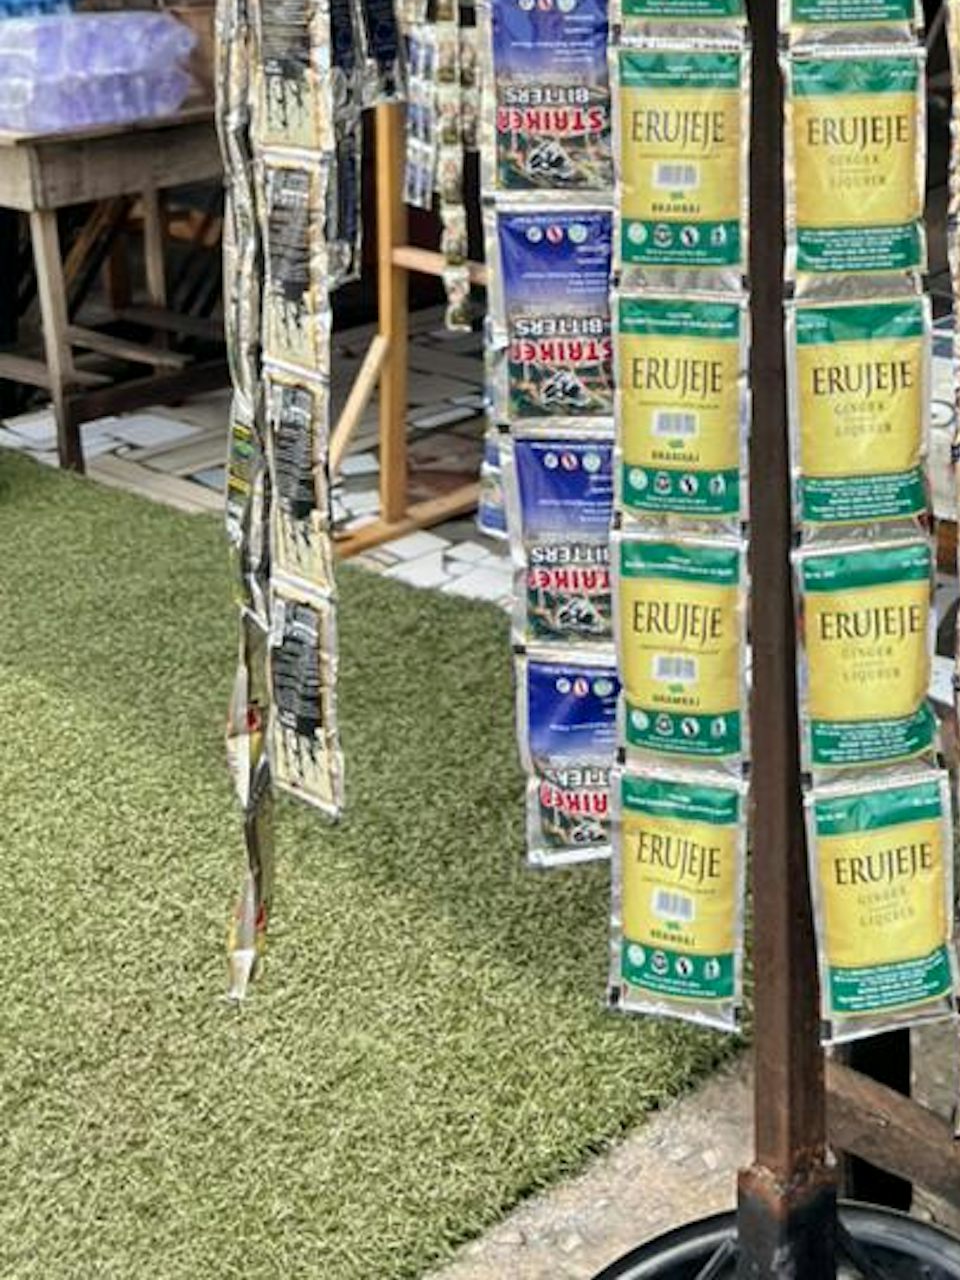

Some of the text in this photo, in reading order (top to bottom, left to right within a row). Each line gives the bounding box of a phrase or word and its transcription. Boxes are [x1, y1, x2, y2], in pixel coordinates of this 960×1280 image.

[505, 87, 590, 104] BITTERS
[497, 107, 604, 136] STRIKER
[632, 109, 726, 146] ERUJEJE
[807, 114, 911, 150] ERUJEJE
[515, 319, 604, 337] BITTERS
[632, 356, 723, 399] ERUJEJE
[812, 359, 914, 398] ERUJEJE
[632, 600, 723, 644] ERUJEJE
[820, 605, 923, 641] ERUJEJE
[636, 830, 722, 884] ERUJEJE
[834, 841, 934, 886] ERUJEJE
